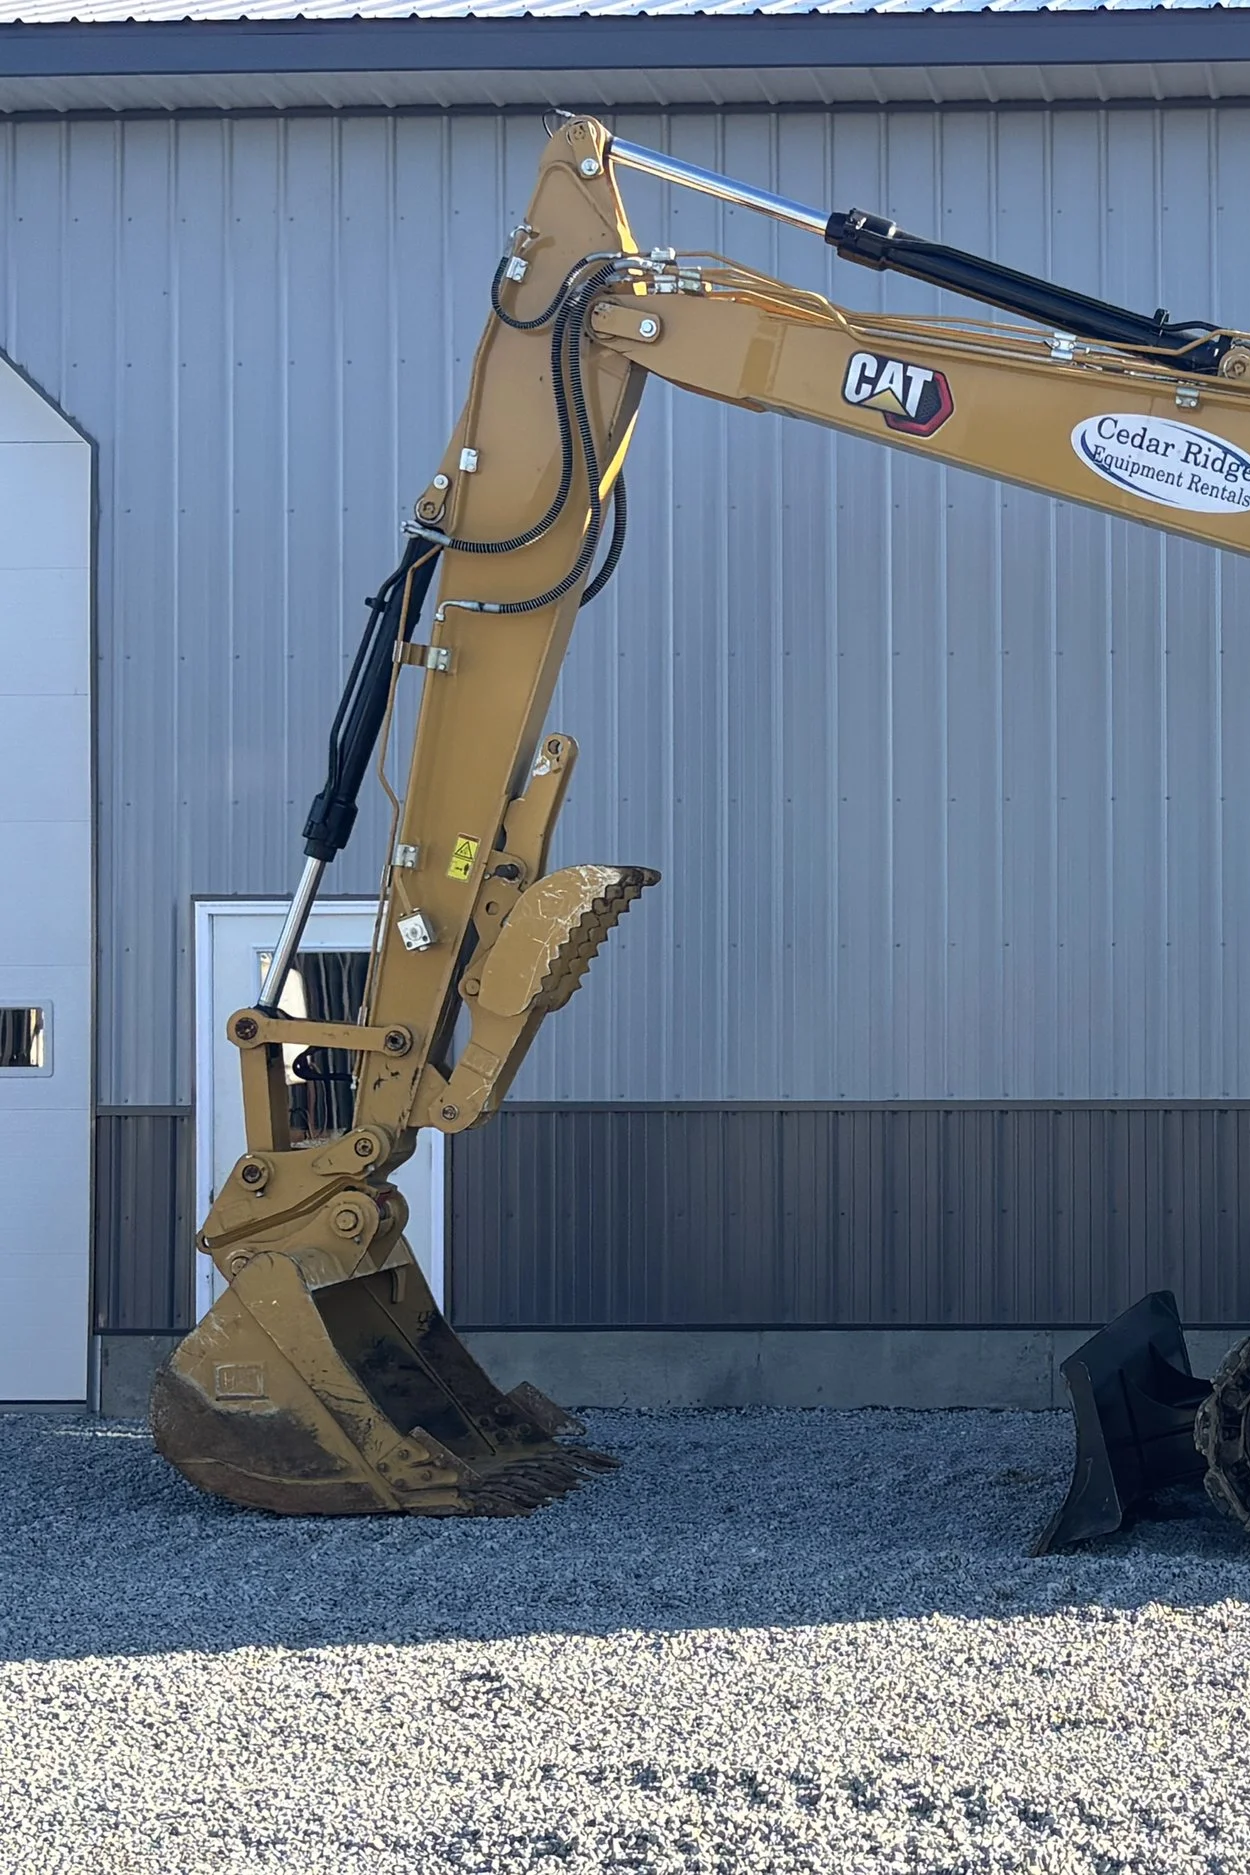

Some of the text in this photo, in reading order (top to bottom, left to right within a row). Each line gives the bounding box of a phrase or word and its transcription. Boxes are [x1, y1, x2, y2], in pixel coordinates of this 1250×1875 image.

[844, 352, 934, 418] CAT
[1097, 416, 1175, 459] Cedar
[1093, 444, 1184, 488] Equipment
